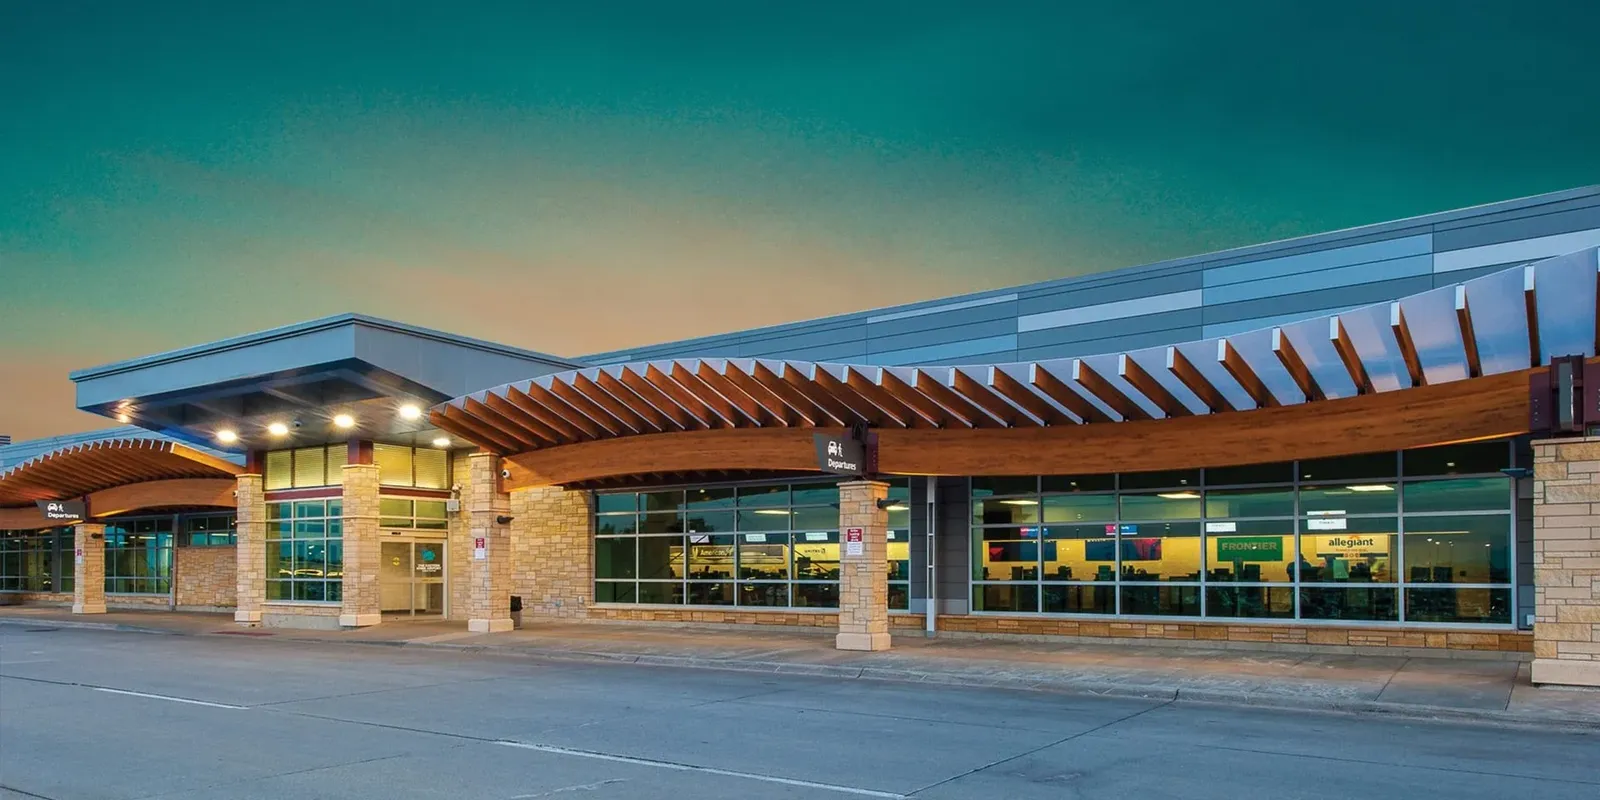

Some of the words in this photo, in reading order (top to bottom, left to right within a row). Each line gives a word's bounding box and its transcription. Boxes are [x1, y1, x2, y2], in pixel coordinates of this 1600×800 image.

[828, 458, 857, 470] Departures
[1221, 542, 1277, 551] FRONTIER
[1328, 537, 1374, 548] allegiant
